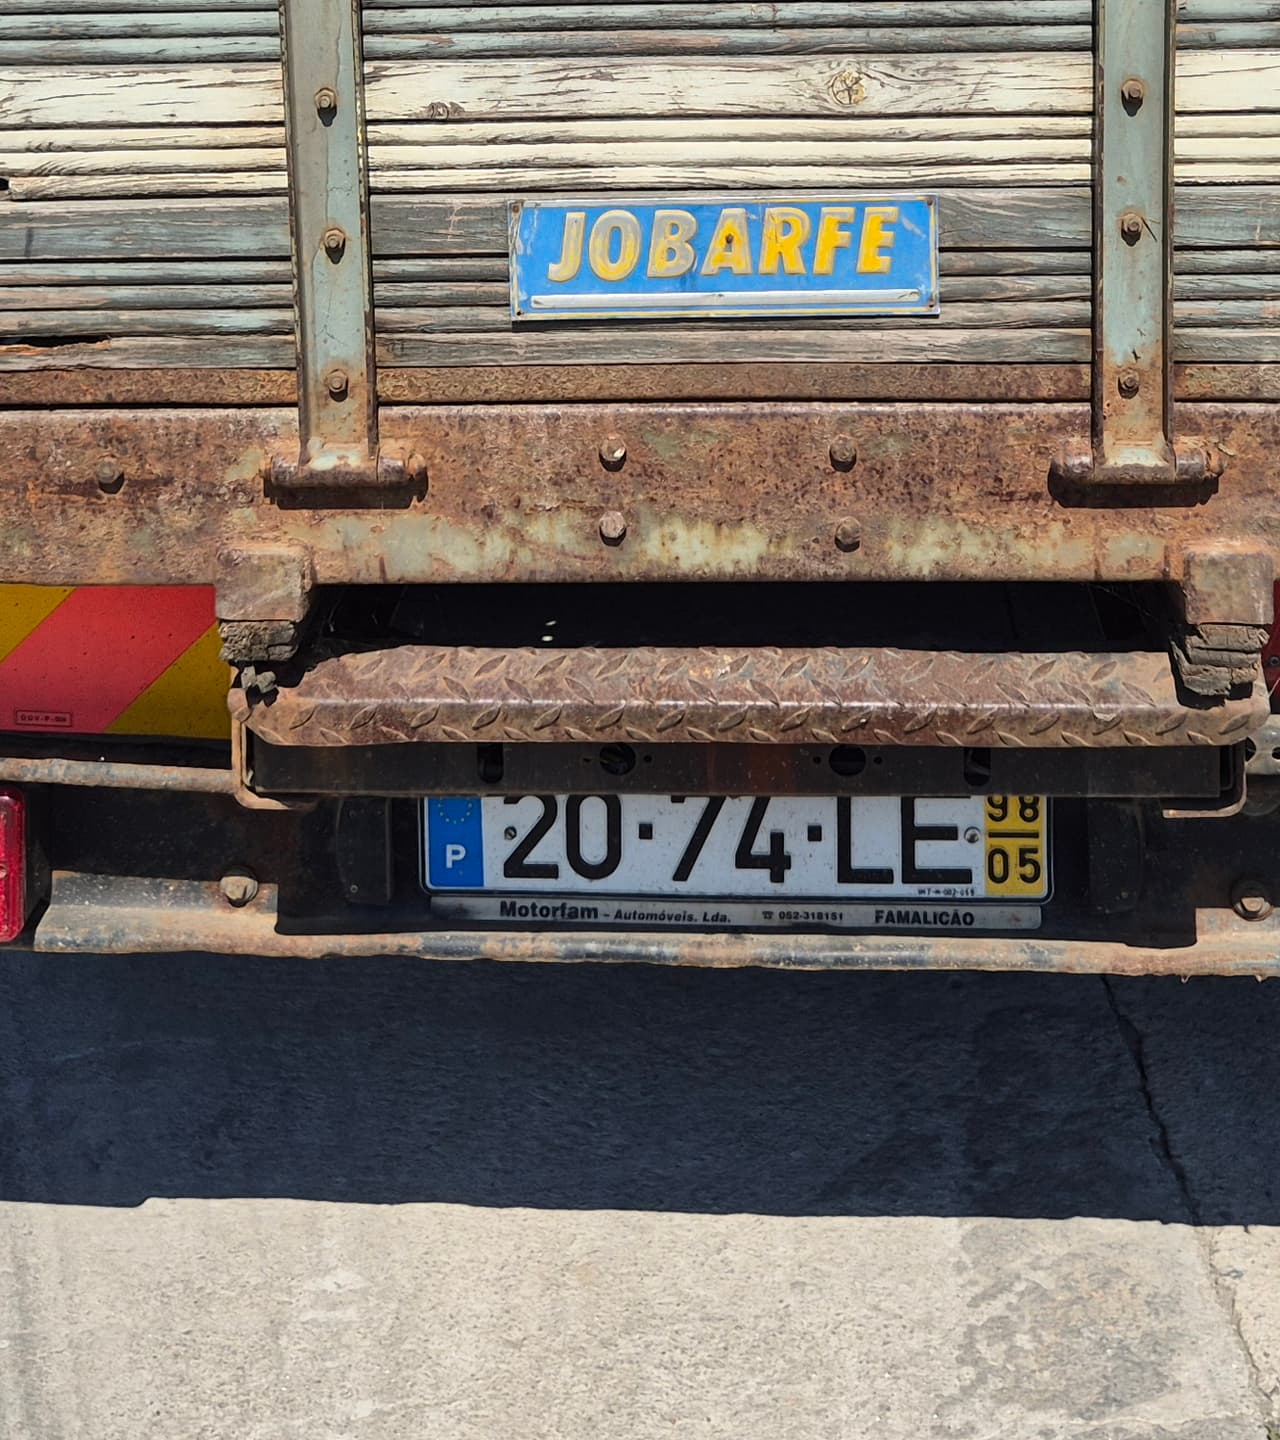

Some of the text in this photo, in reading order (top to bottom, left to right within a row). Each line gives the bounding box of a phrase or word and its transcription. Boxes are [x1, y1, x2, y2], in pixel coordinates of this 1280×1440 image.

[547, 206, 899, 282] JOBARFE
[445, 844, 466, 869] P
[988, 848, 1041, 884] 05
[500, 901, 599, 920] Motorfam
[702, 912, 731, 924] Lda.
[874, 910, 976, 926] FAMALICÃO
